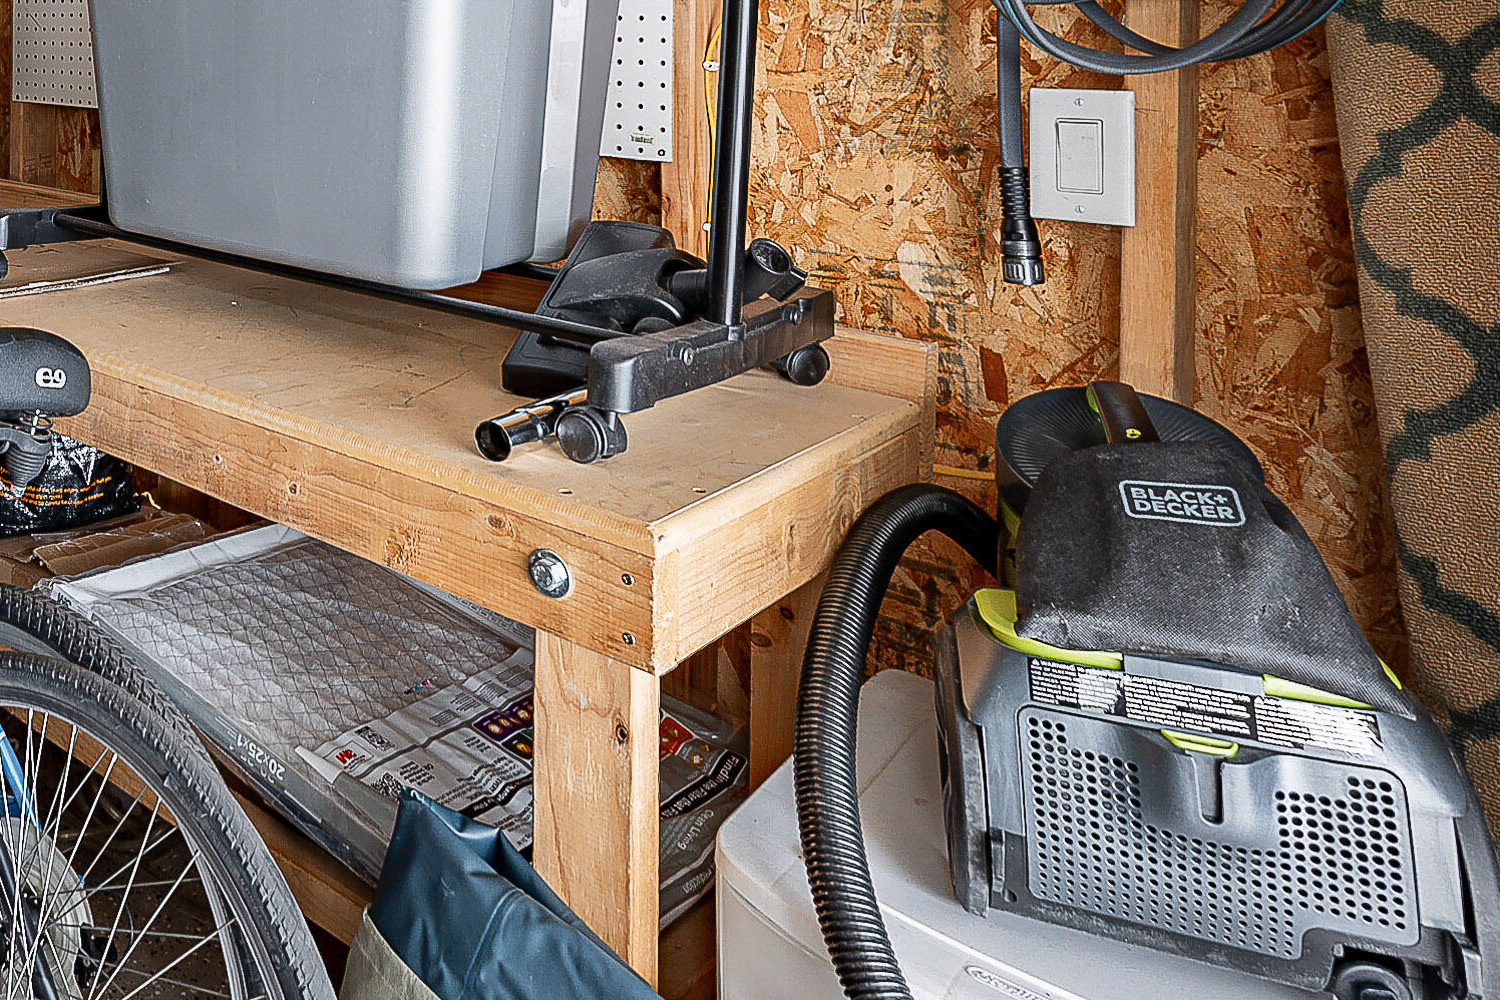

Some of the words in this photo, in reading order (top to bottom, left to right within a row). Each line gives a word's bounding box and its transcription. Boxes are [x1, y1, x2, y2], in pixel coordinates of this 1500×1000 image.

[1130, 487, 1228, 505] BLACK+
[1134, 499, 1236, 520] DECKER
[235, 733, 286, 780] 20x25x1
[336, 750, 358, 765] 3M
[674, 797, 692, 811] that
[694, 808, 715, 831] Clean
[677, 825, 701, 852] Living
